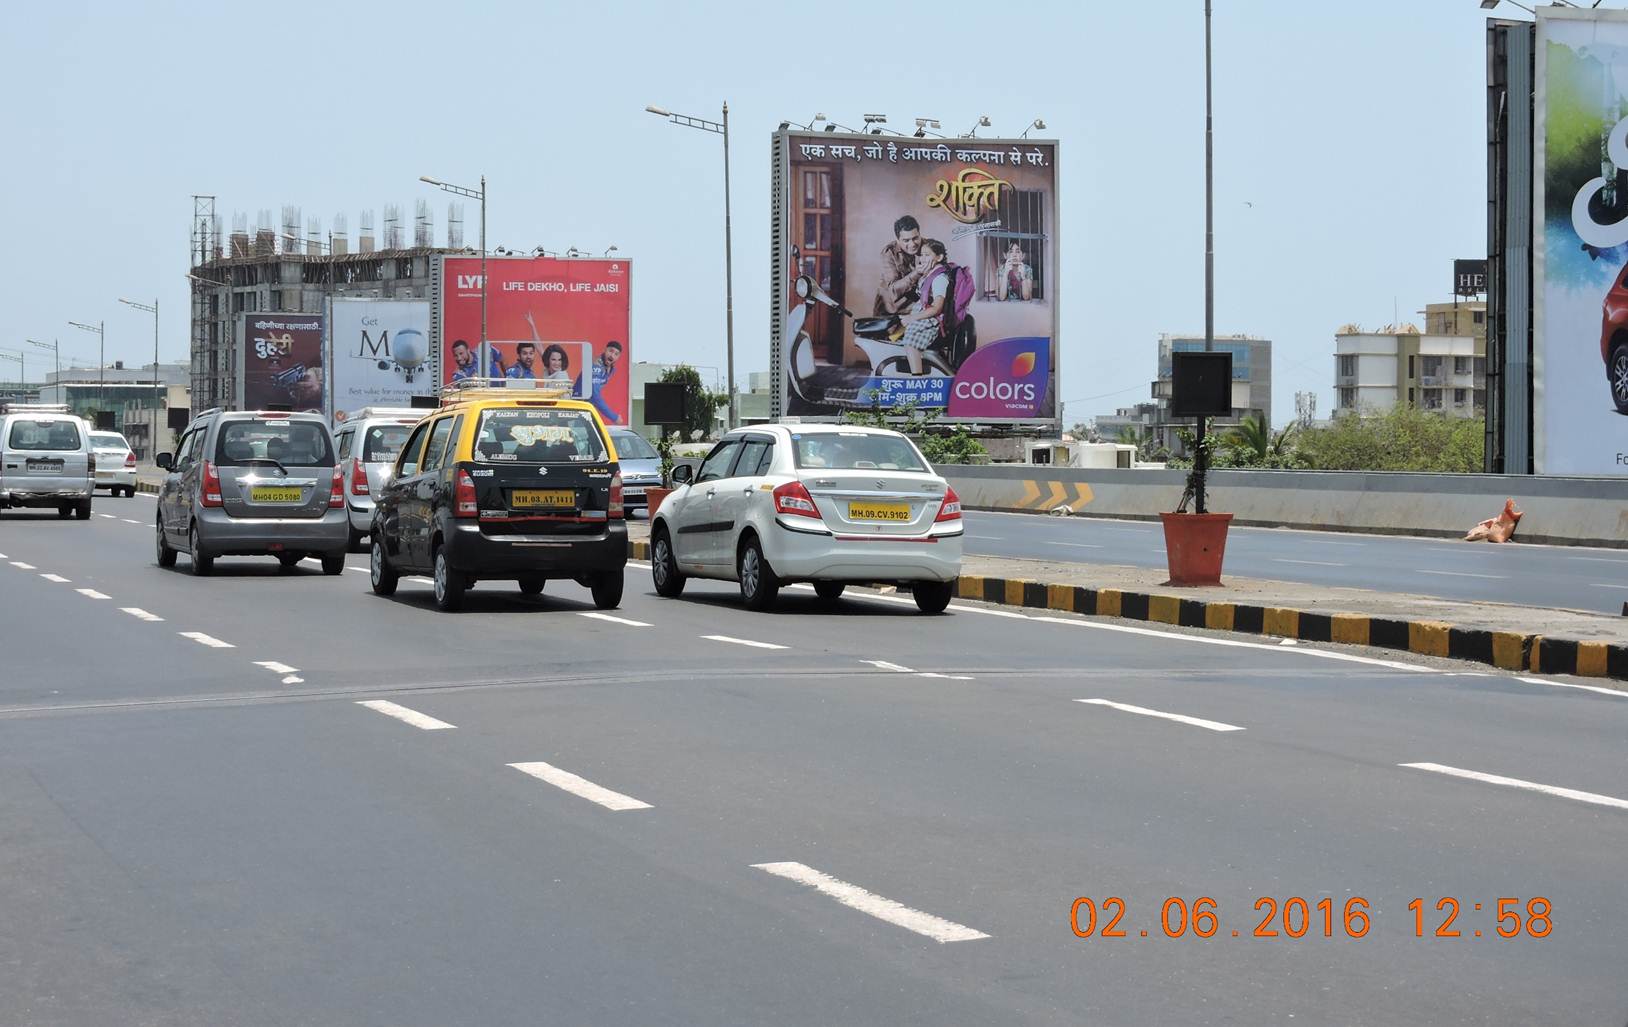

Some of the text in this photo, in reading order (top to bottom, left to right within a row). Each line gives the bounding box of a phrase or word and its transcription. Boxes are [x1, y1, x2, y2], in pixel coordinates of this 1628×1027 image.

[800, 141, 1050, 167] एक सच, जो है आपकी कल्पना से परे.
[926, 167, 1016, 224] शक्ति
[503, 281, 619, 293] LIFE DEKHO, LIFE JAISI
[361, 316, 378, 326] Get
[881, 379, 943, 393] शुरू MAY 30
[955, 376, 1036, 401] colors
[919, 392, 943, 402] 8PM
[850, 508, 909, 520] MH.09.CV.9102
